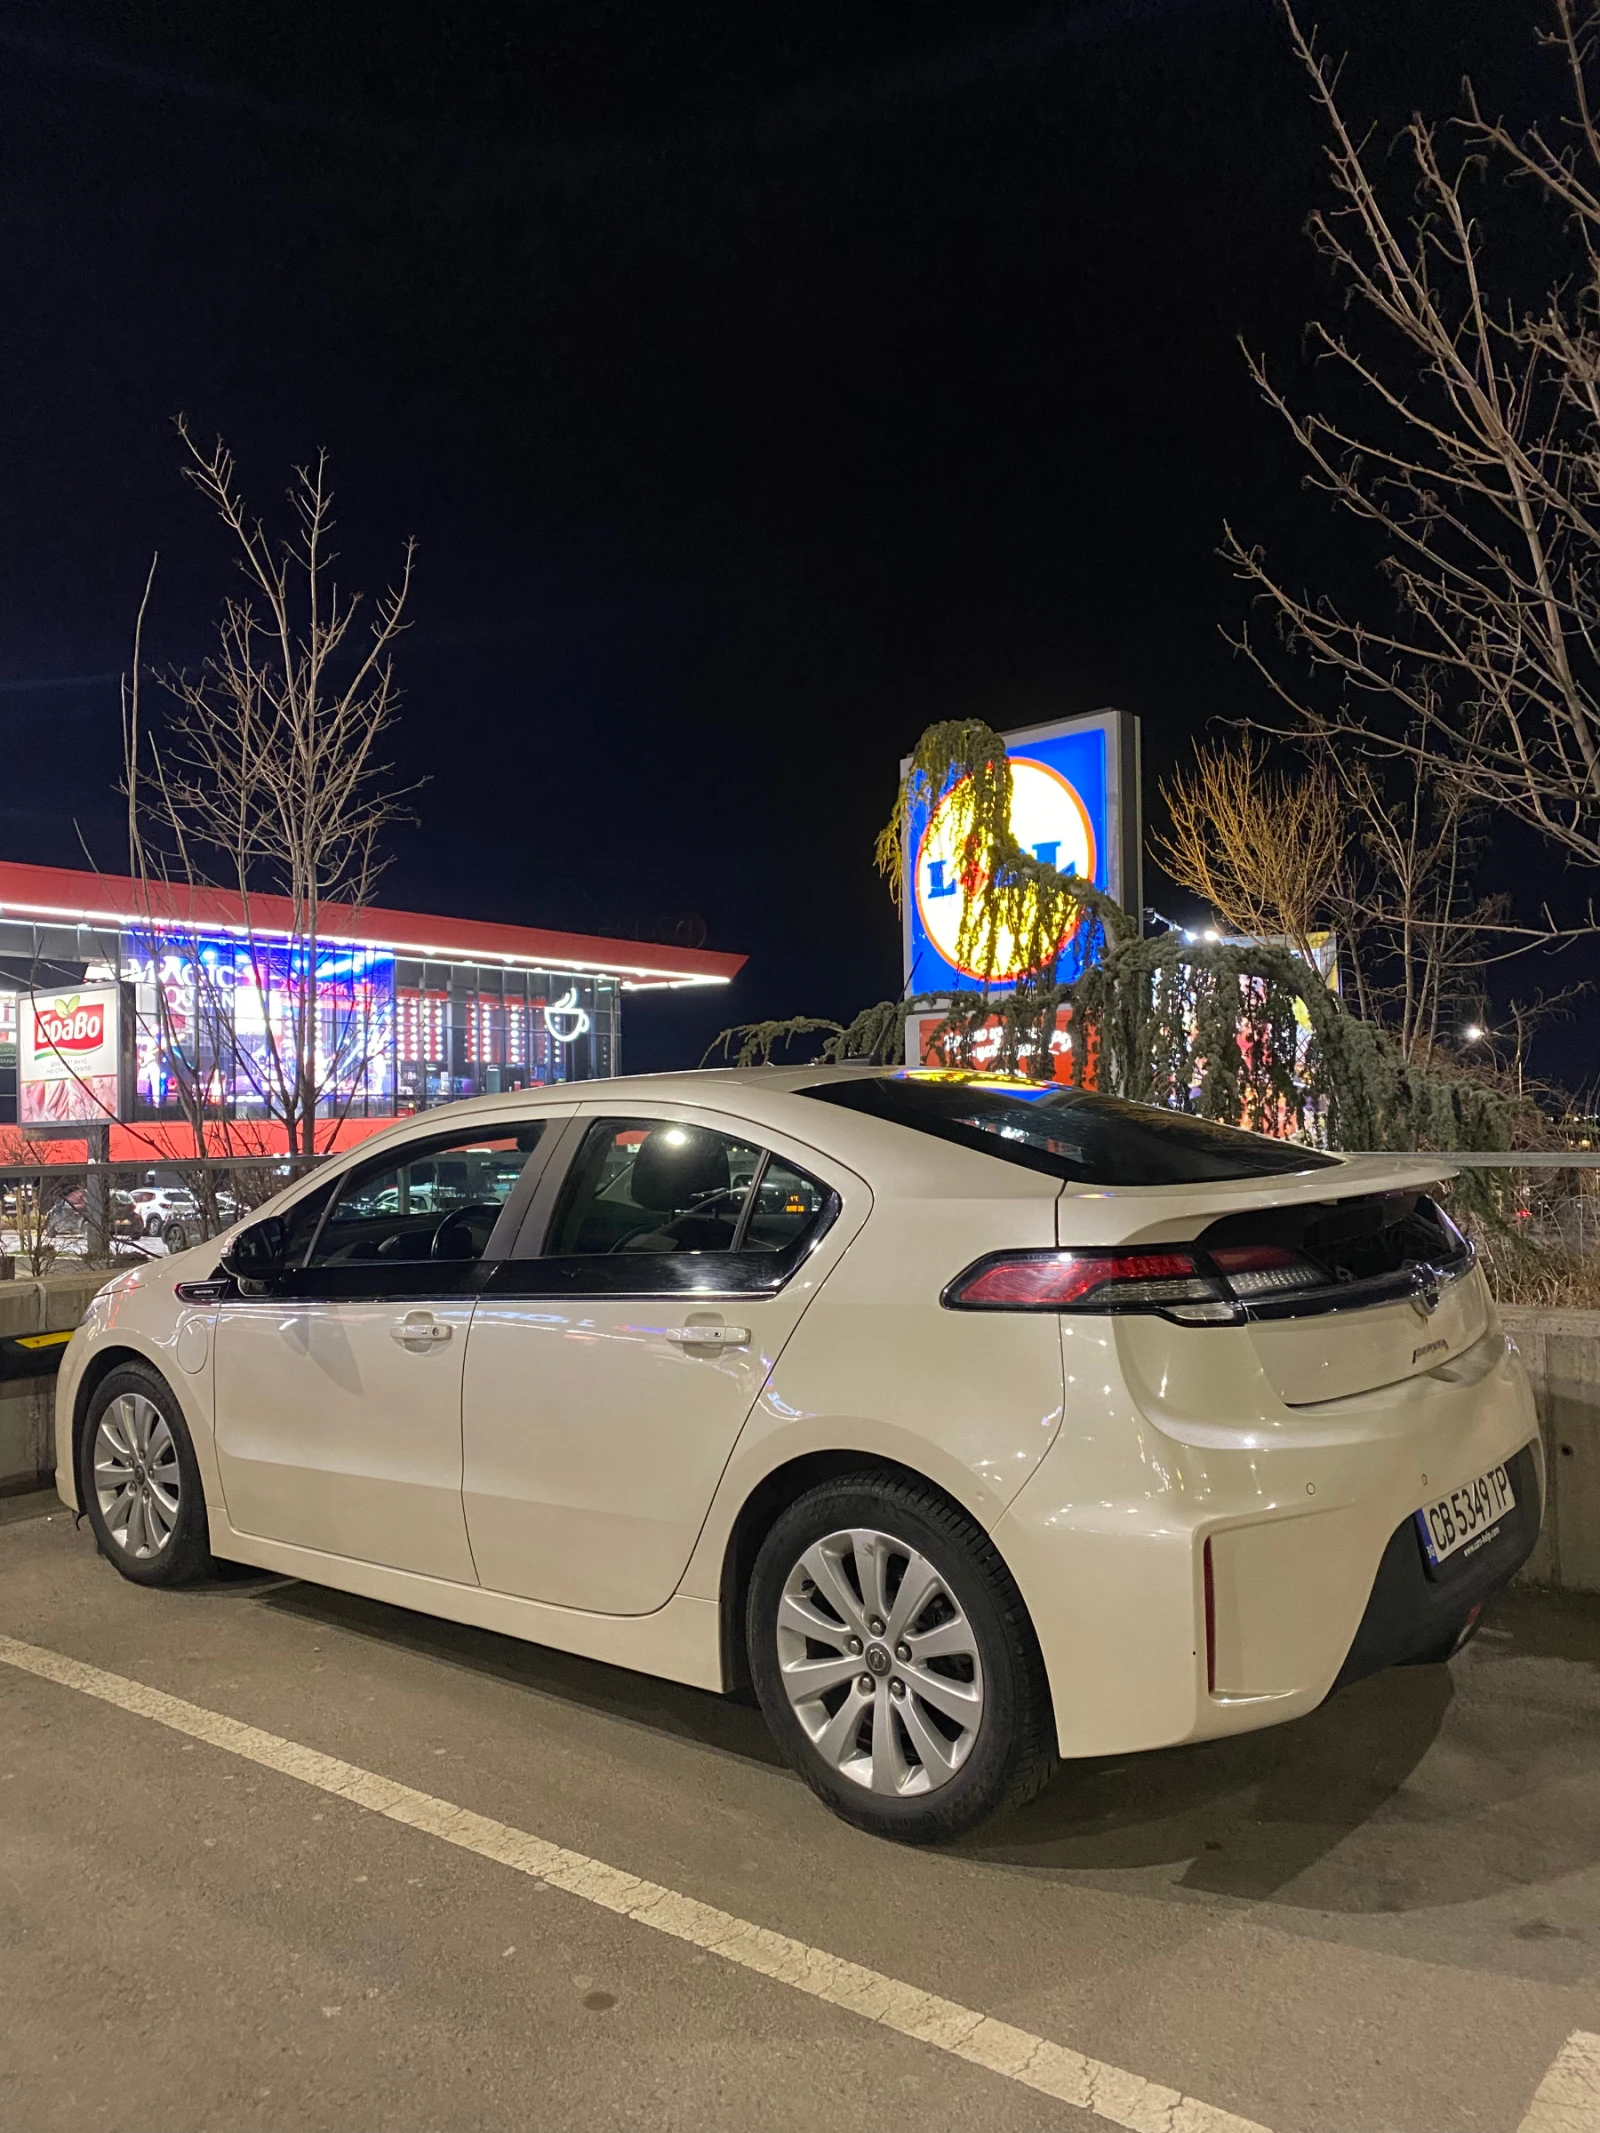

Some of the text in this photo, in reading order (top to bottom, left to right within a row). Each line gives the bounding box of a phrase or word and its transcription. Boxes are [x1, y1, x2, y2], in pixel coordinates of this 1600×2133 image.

[927, 841, 1077, 899] LL
[1429, 1466, 1507, 1551] CB 5349 TP
